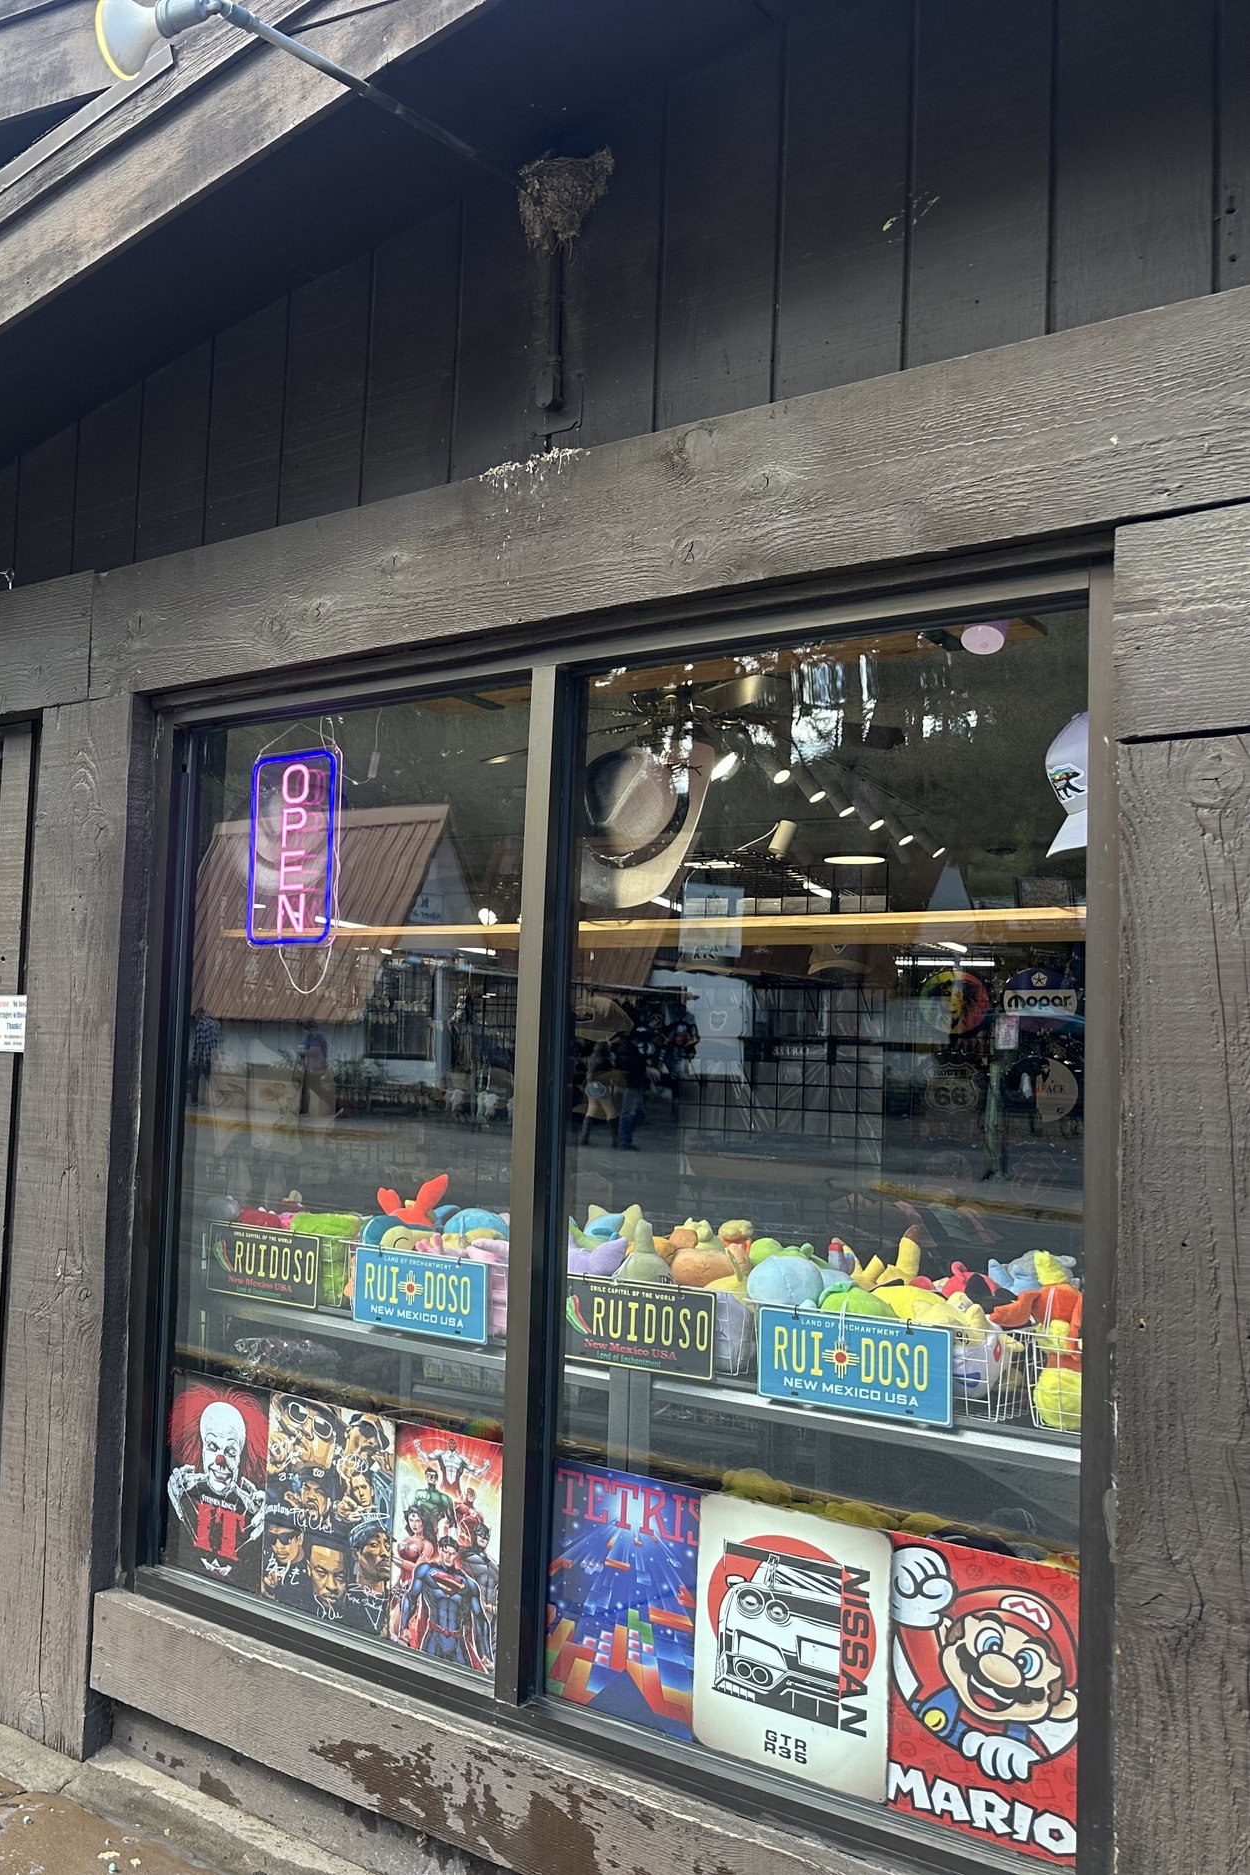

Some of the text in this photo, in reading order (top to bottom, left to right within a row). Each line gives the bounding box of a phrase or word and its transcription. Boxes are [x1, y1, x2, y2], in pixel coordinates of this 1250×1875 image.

[276, 763, 310, 933] OPEN
[933, 1086, 967, 1106] 66
[234, 1240, 315, 1285] RUIDOSO
[409, 1258, 452, 1270] ENCHANTMENT
[245, 1278, 273, 1289] Mexico
[274, 1282, 293, 1293] USA
[364, 1262, 471, 1315] RUI DOSO
[590, 1285, 606, 1293] CHILE
[608, 1287, 630, 1296] CAPITAL
[641, 1291, 653, 1299] THE
[655, 1293, 675, 1302] WORLD
[370, 1304, 464, 1328] NEW MEXICO USA
[592, 1296, 709, 1352] RUIDOSO
[801, 1318, 822, 1327] LAND
[824, 1321, 835, 1329] OF
[584, 1338, 678, 1361] New Mexico USA
[597, 1350, 661, 1368] Land of Enchantment
[774, 1325, 929, 1392] RUI DOSO
[783, 1376, 919, 1407] NEW MEXICO USA
[193, 1500, 246, 1561] IT
[840, 1564, 871, 1738] NISSAN
[764, 1740, 808, 1765] R35
[765, 1729, 808, 1752] GTR
[887, 1760, 1077, 1854] MARIO
